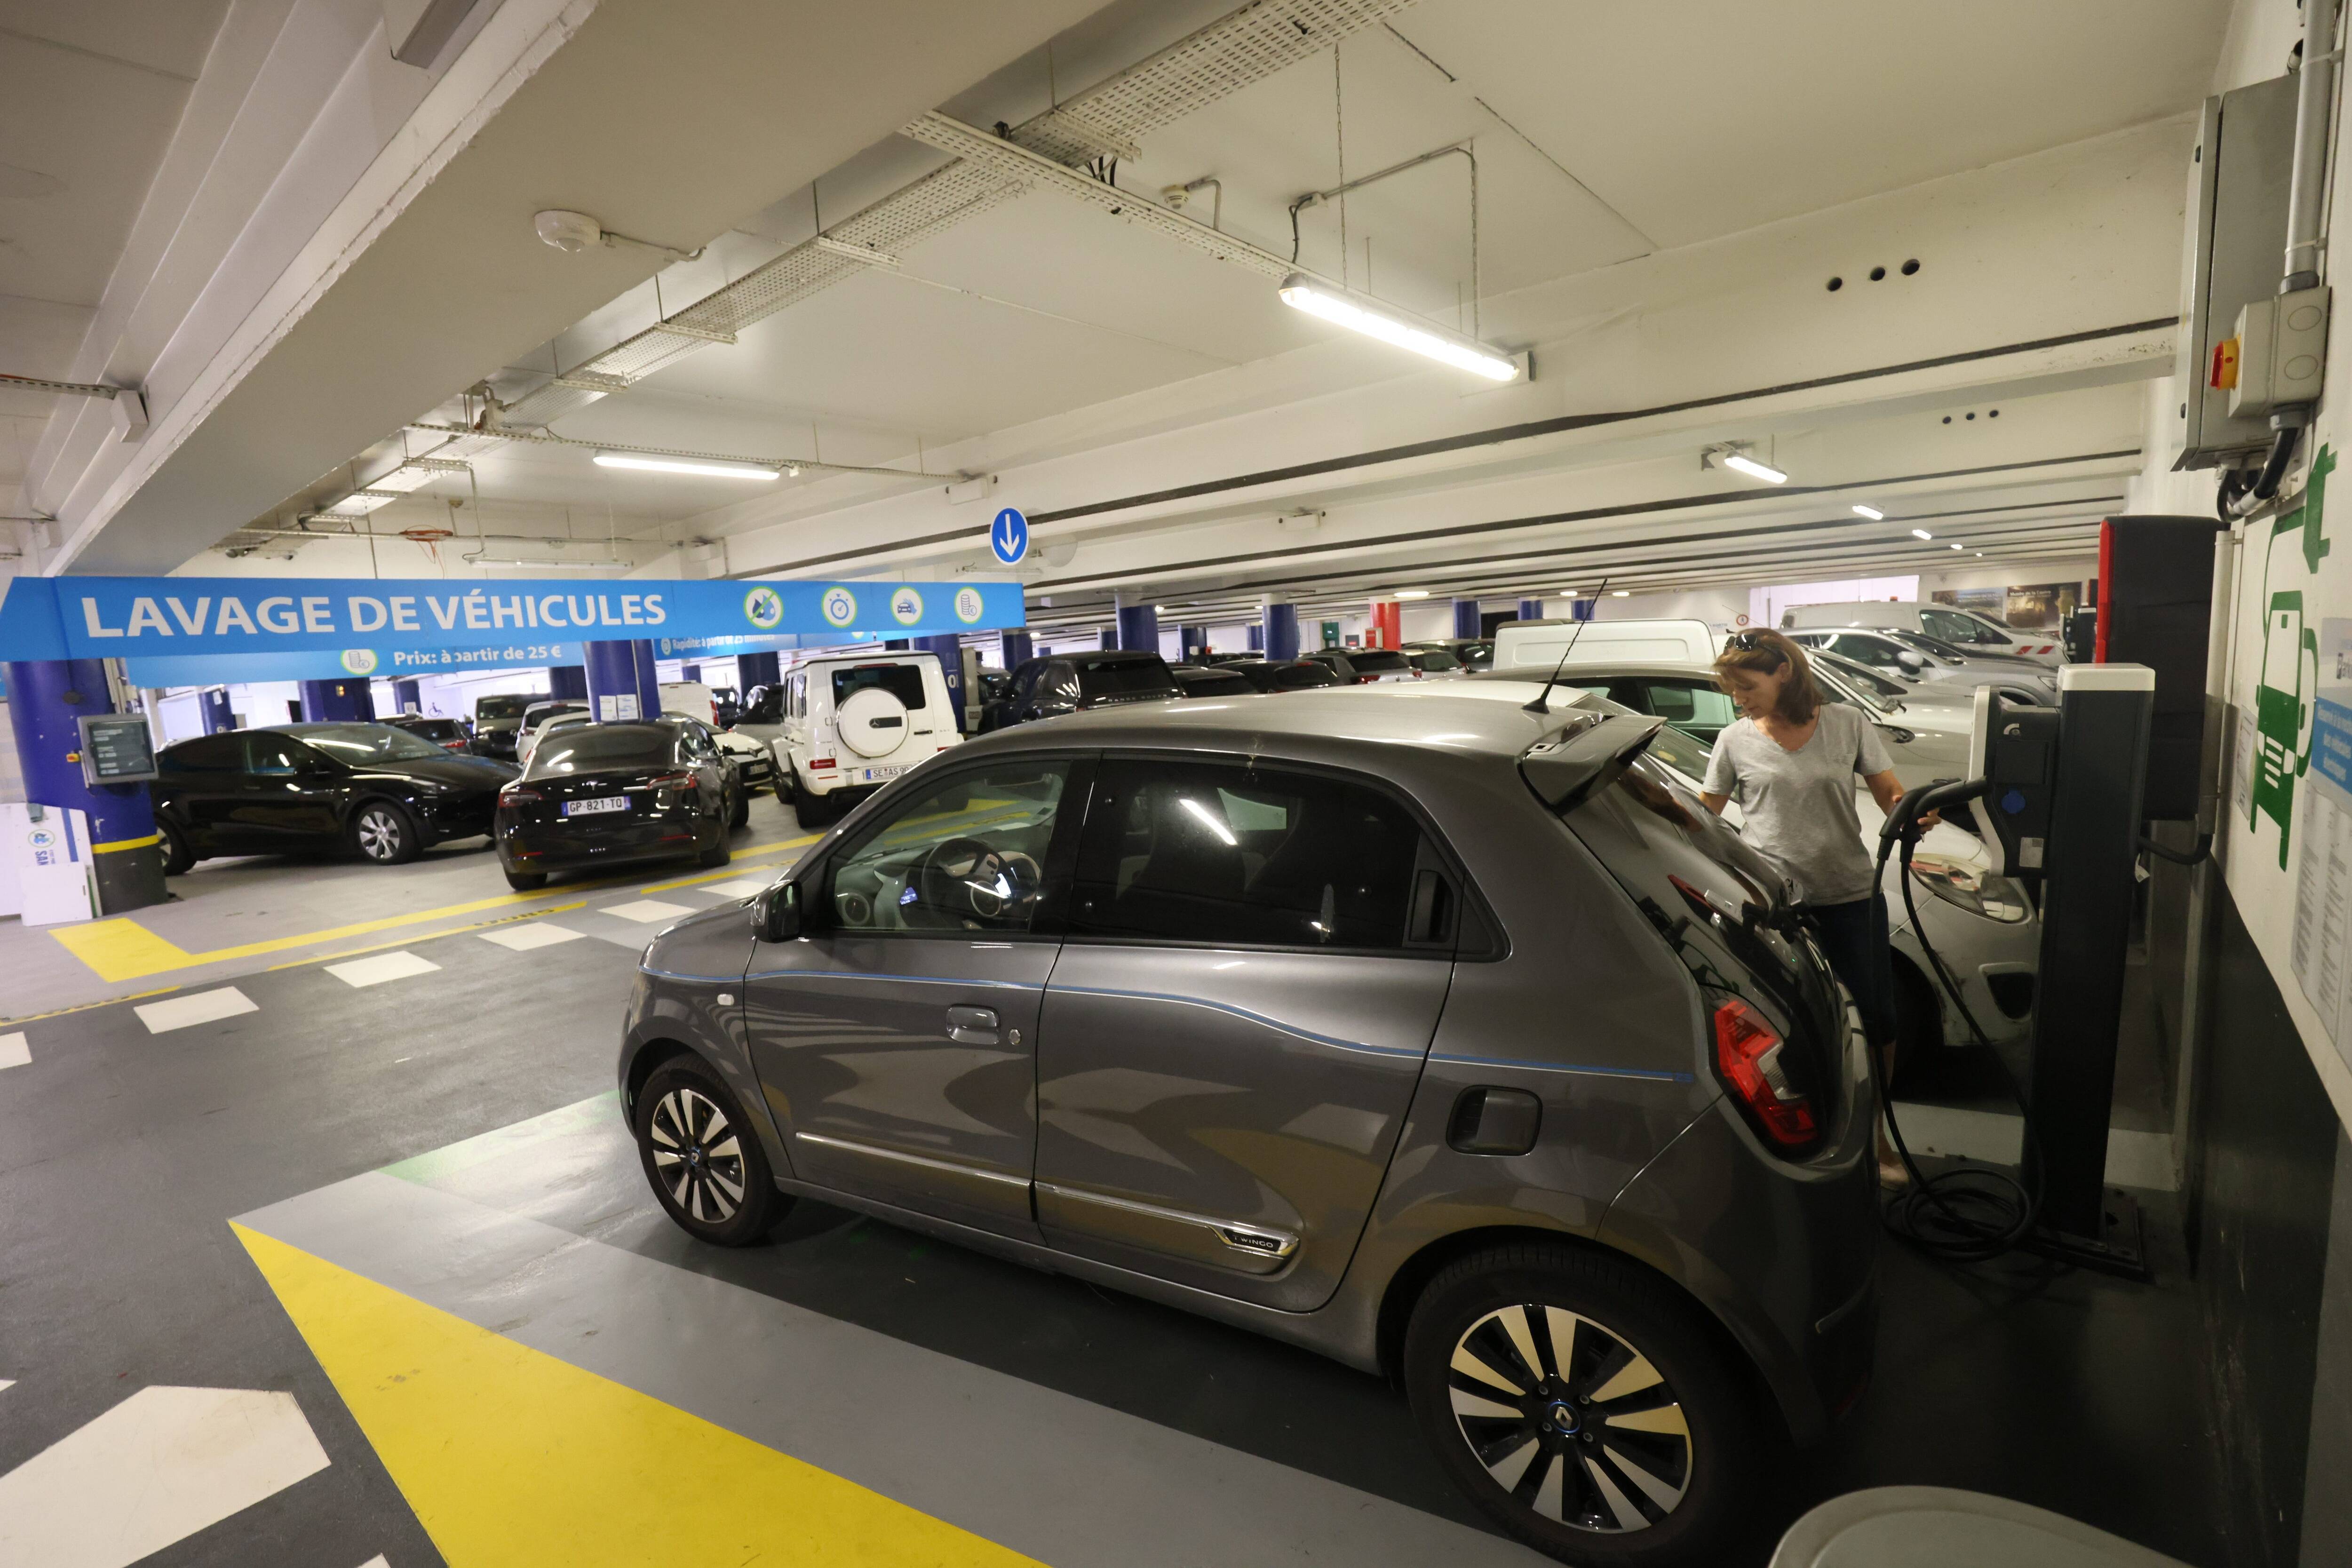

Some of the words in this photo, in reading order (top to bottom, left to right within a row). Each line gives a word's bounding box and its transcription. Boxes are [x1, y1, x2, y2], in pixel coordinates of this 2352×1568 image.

[81, 596, 335, 637] LAVAGE
[348, 596, 421, 631] DE
[425, 588, 666, 630] VÉHICULES
[393, 650, 437, 666] Prix:
[441, 649, 452, 664] à
[503, 646, 524, 660] de
[527, 646, 548, 659] 25
[550, 645, 562, 658] €
[569, 798, 622, 812] GP-821-TQ
[1234, 1235, 1273, 1248] TWINGO
